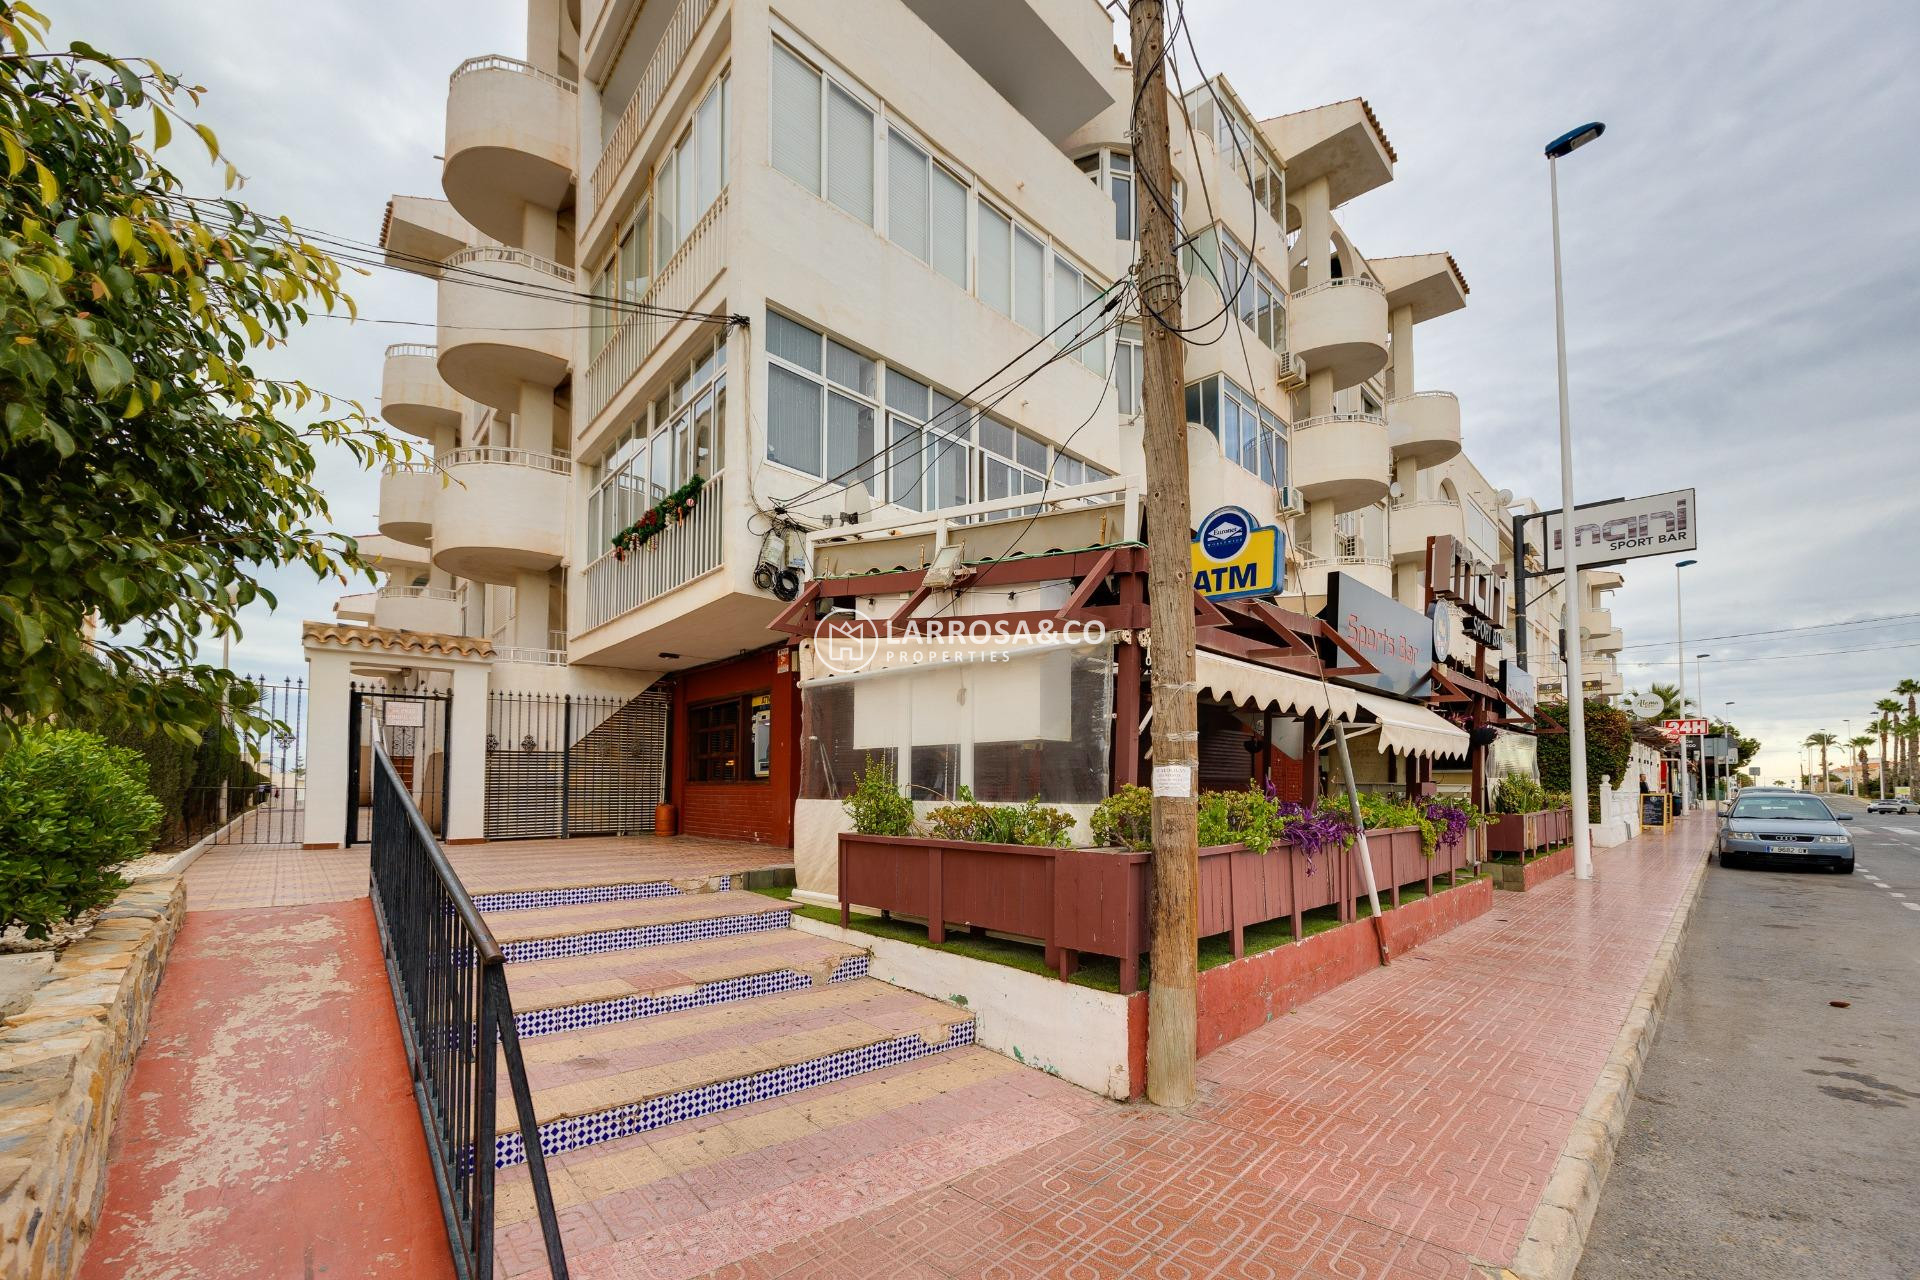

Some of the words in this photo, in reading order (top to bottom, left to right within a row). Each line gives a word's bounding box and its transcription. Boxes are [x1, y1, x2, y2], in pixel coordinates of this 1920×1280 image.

[1610, 537, 1653, 551] SPORT
[1658, 532, 1687, 544] BAR
[1194, 563, 1257, 593] ATM
[1347, 613, 1395, 658] Sports
[1399, 634, 1419, 666] Bar
[1668, 720, 1706, 734] 24H
